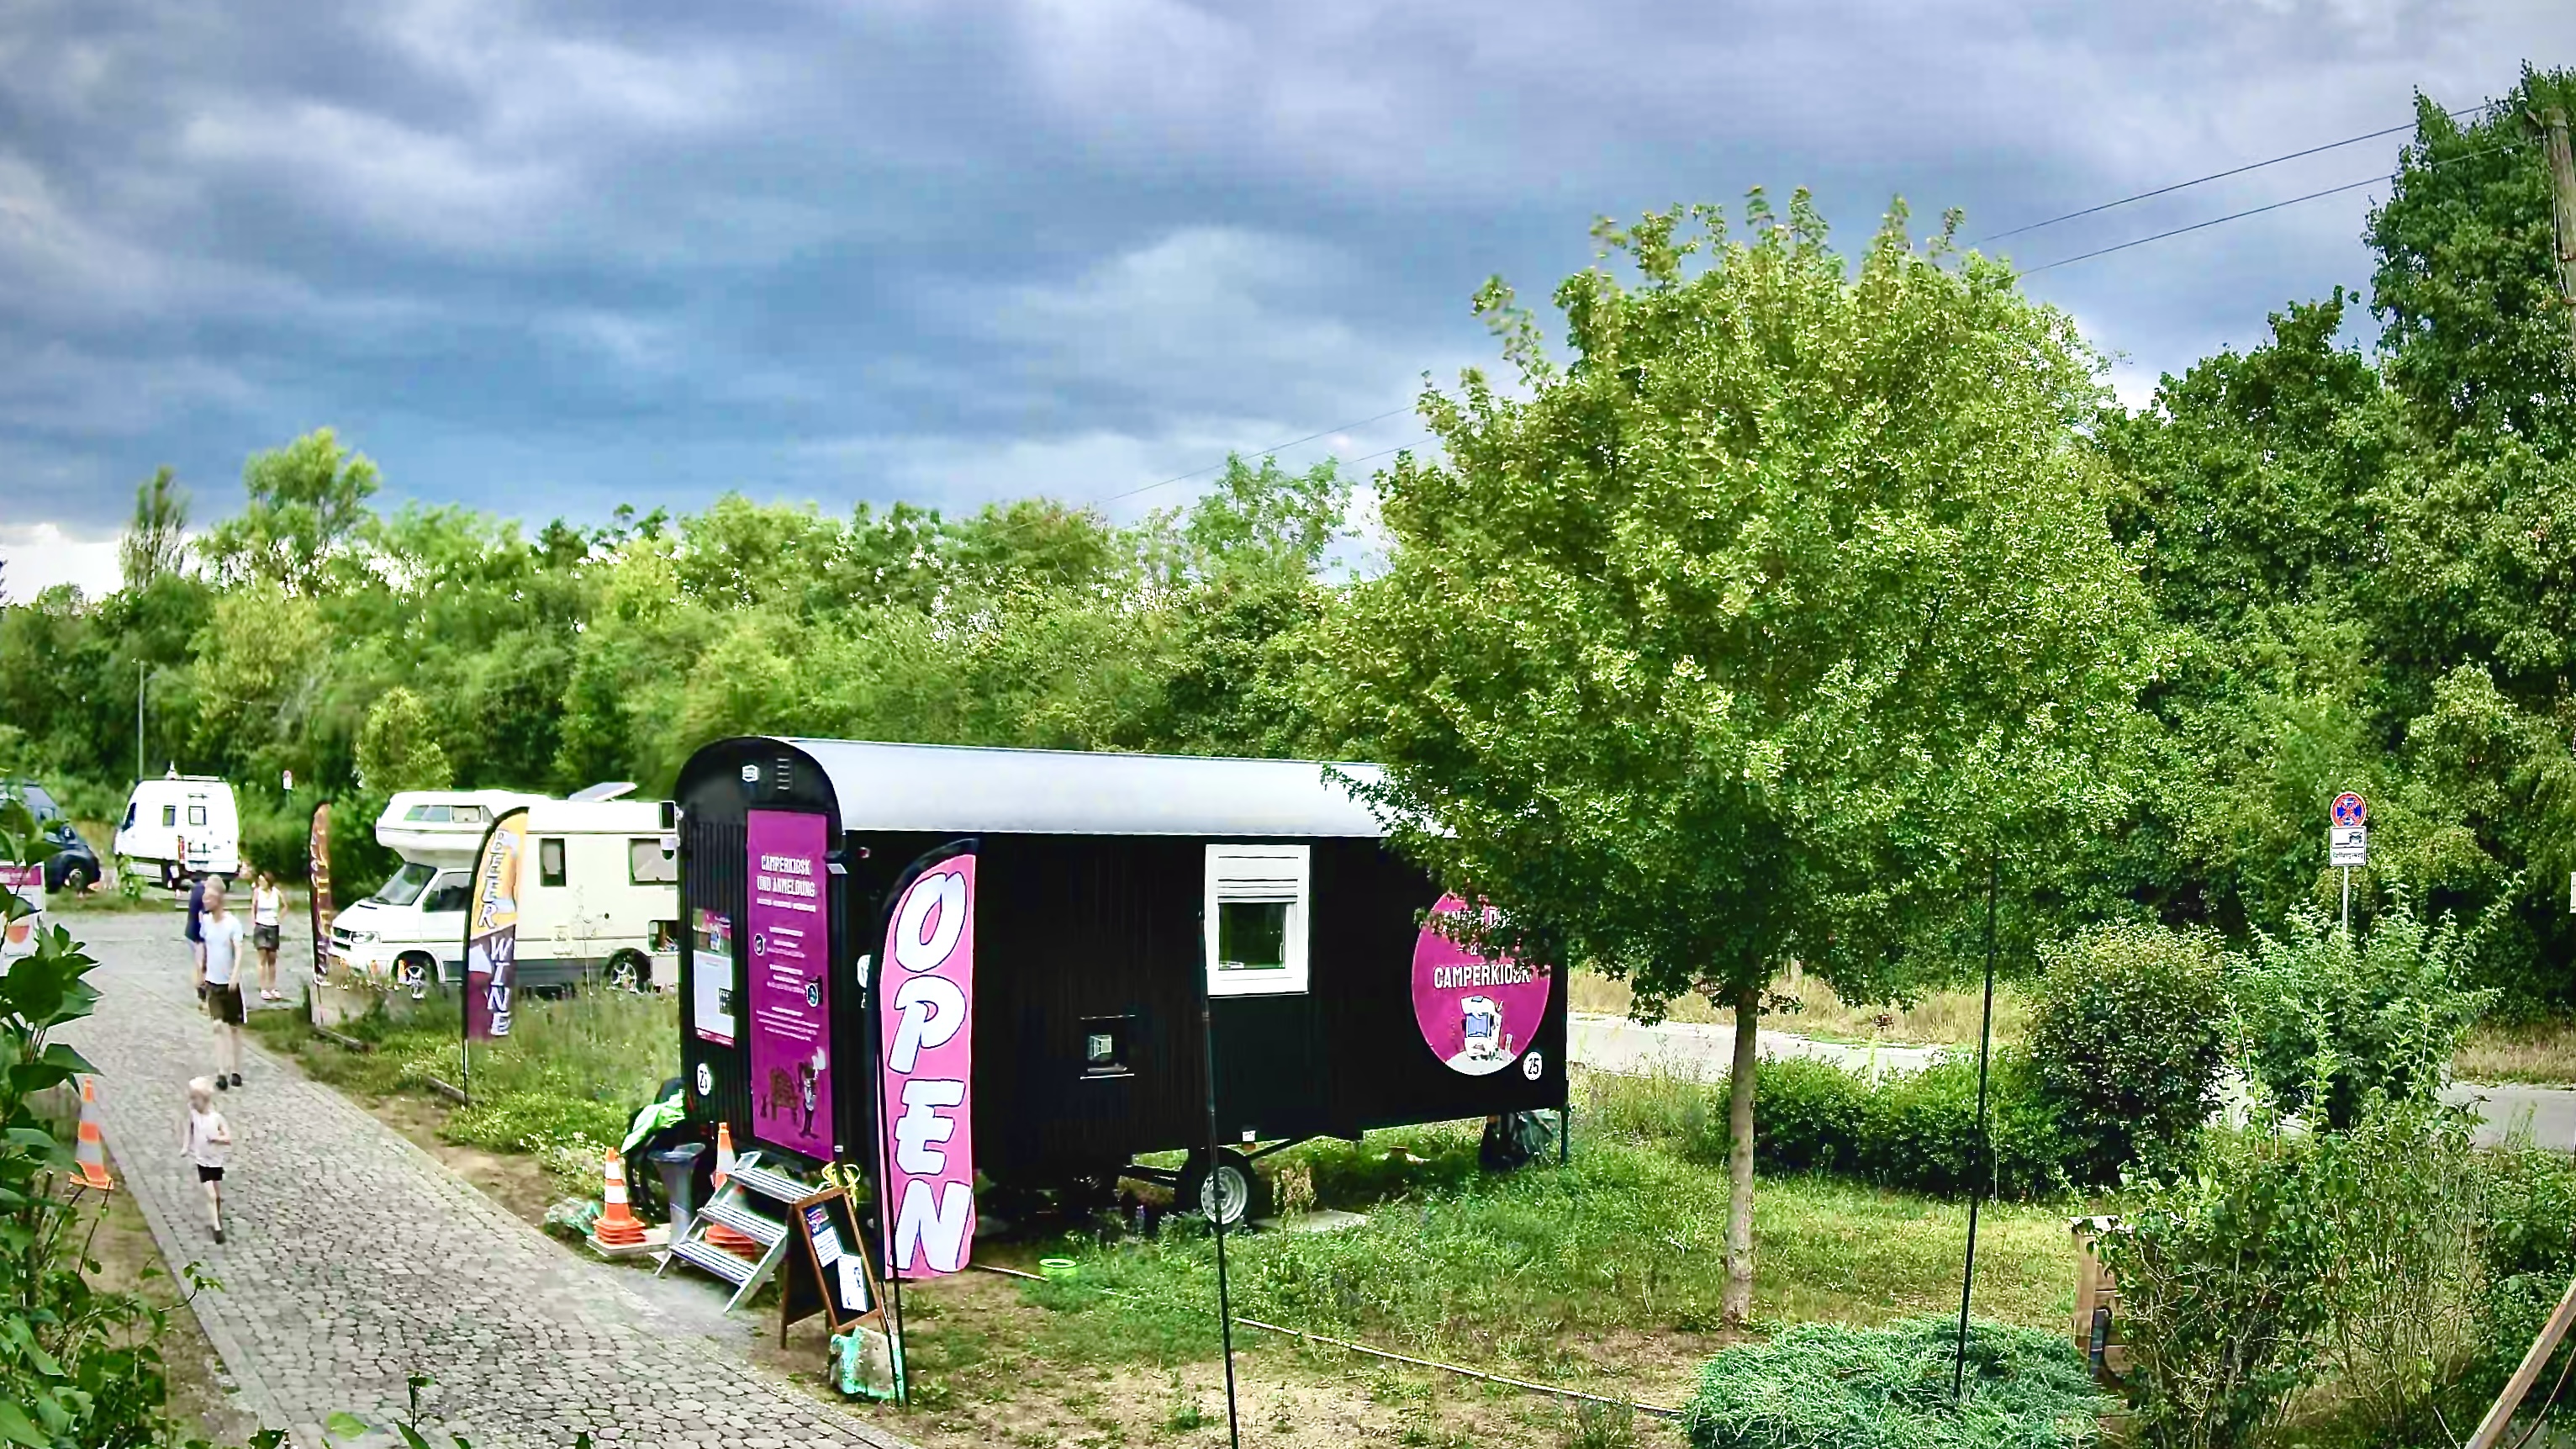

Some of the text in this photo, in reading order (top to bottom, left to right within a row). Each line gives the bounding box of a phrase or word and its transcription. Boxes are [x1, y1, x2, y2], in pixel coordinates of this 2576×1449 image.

[478, 828, 509, 929] BEER
[487, 936, 513, 1037] WINE
[887, 871, 973, 1273] OPEN
[1527, 1056, 1540, 1076] 25
